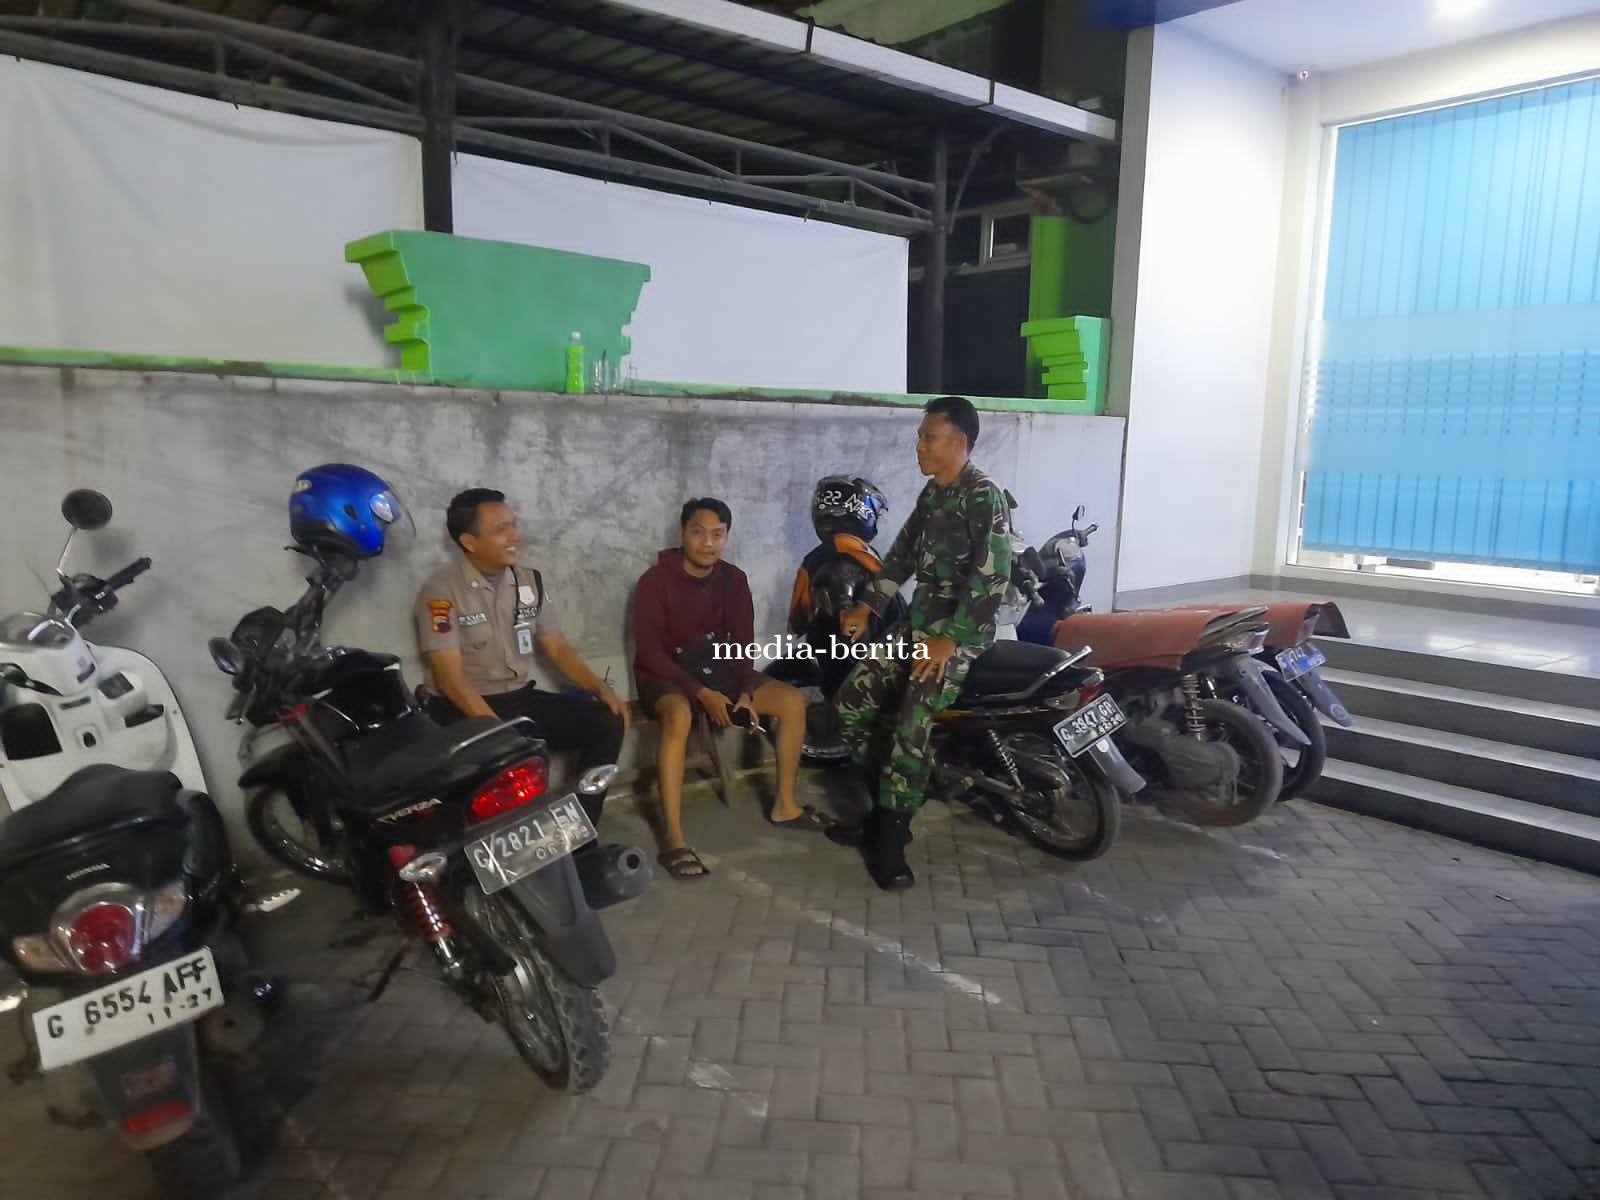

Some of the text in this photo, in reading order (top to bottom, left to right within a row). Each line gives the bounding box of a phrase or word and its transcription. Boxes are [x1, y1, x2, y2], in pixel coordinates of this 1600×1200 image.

[495, 819, 545, 858] 2821
[47, 957, 207, 1039] G 6554 AFF
